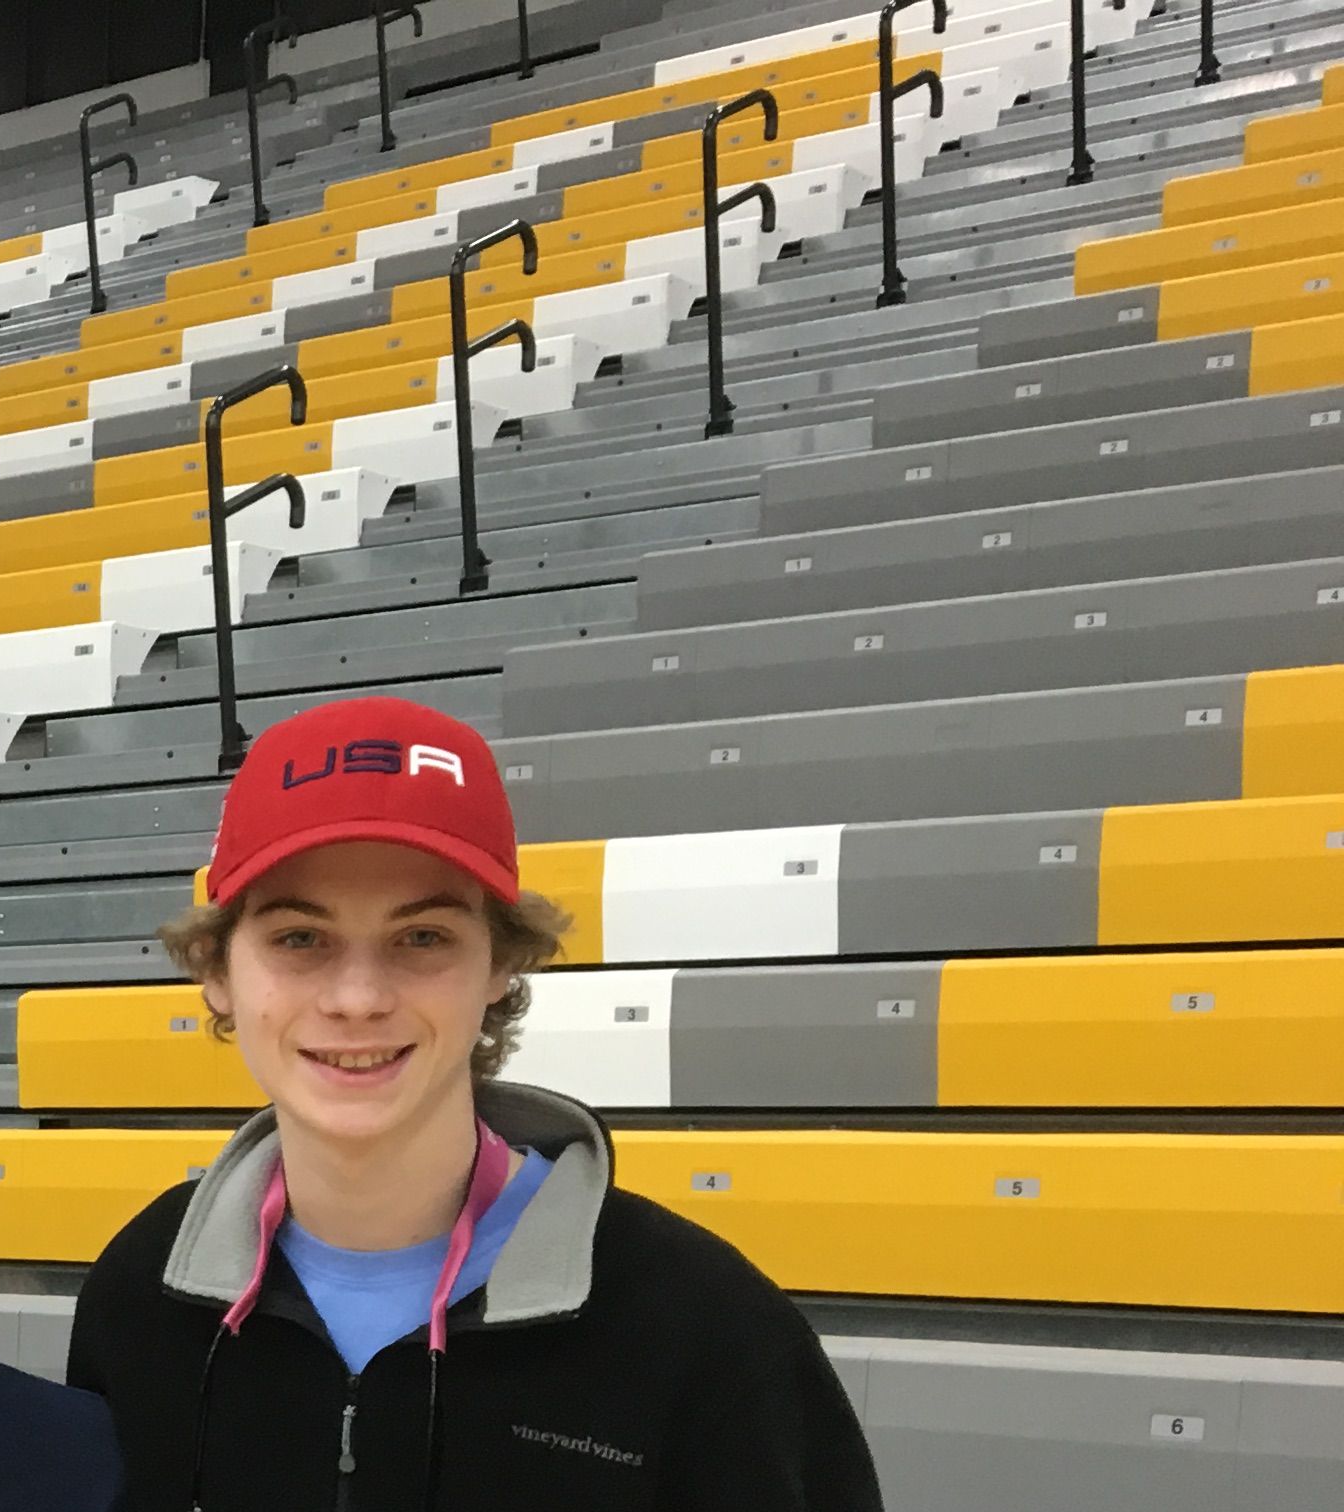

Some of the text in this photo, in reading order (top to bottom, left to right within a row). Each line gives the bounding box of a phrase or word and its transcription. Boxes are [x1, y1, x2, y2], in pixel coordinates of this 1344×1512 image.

[1216, 358, 1224, 367] 2
[1321, 413, 1329, 423] 3
[1110, 443, 1118, 452] 2
[993, 535, 1000, 545] 2
[1330, 590, 1340, 600] 4
[1087, 615, 1094, 625] 3
[865, 637, 872, 648] 2
[1200, 712, 1208, 722] 4
[722, 751, 729, 761] 2
[282, 739, 465, 790] USA
[1054, 848, 1062, 859] 4
[797, 863, 804, 874] 3
[1188, 996, 1197, 1009] 5
[892, 1003, 900, 1014] 4
[628, 1009, 635, 1020] 3
[707, 1176, 715, 1188] 4
[1012, 1182, 1022, 1195] 5
[1172, 1418, 1183, 1434] 6
[511, 1424, 645, 1467] vineyard vines
